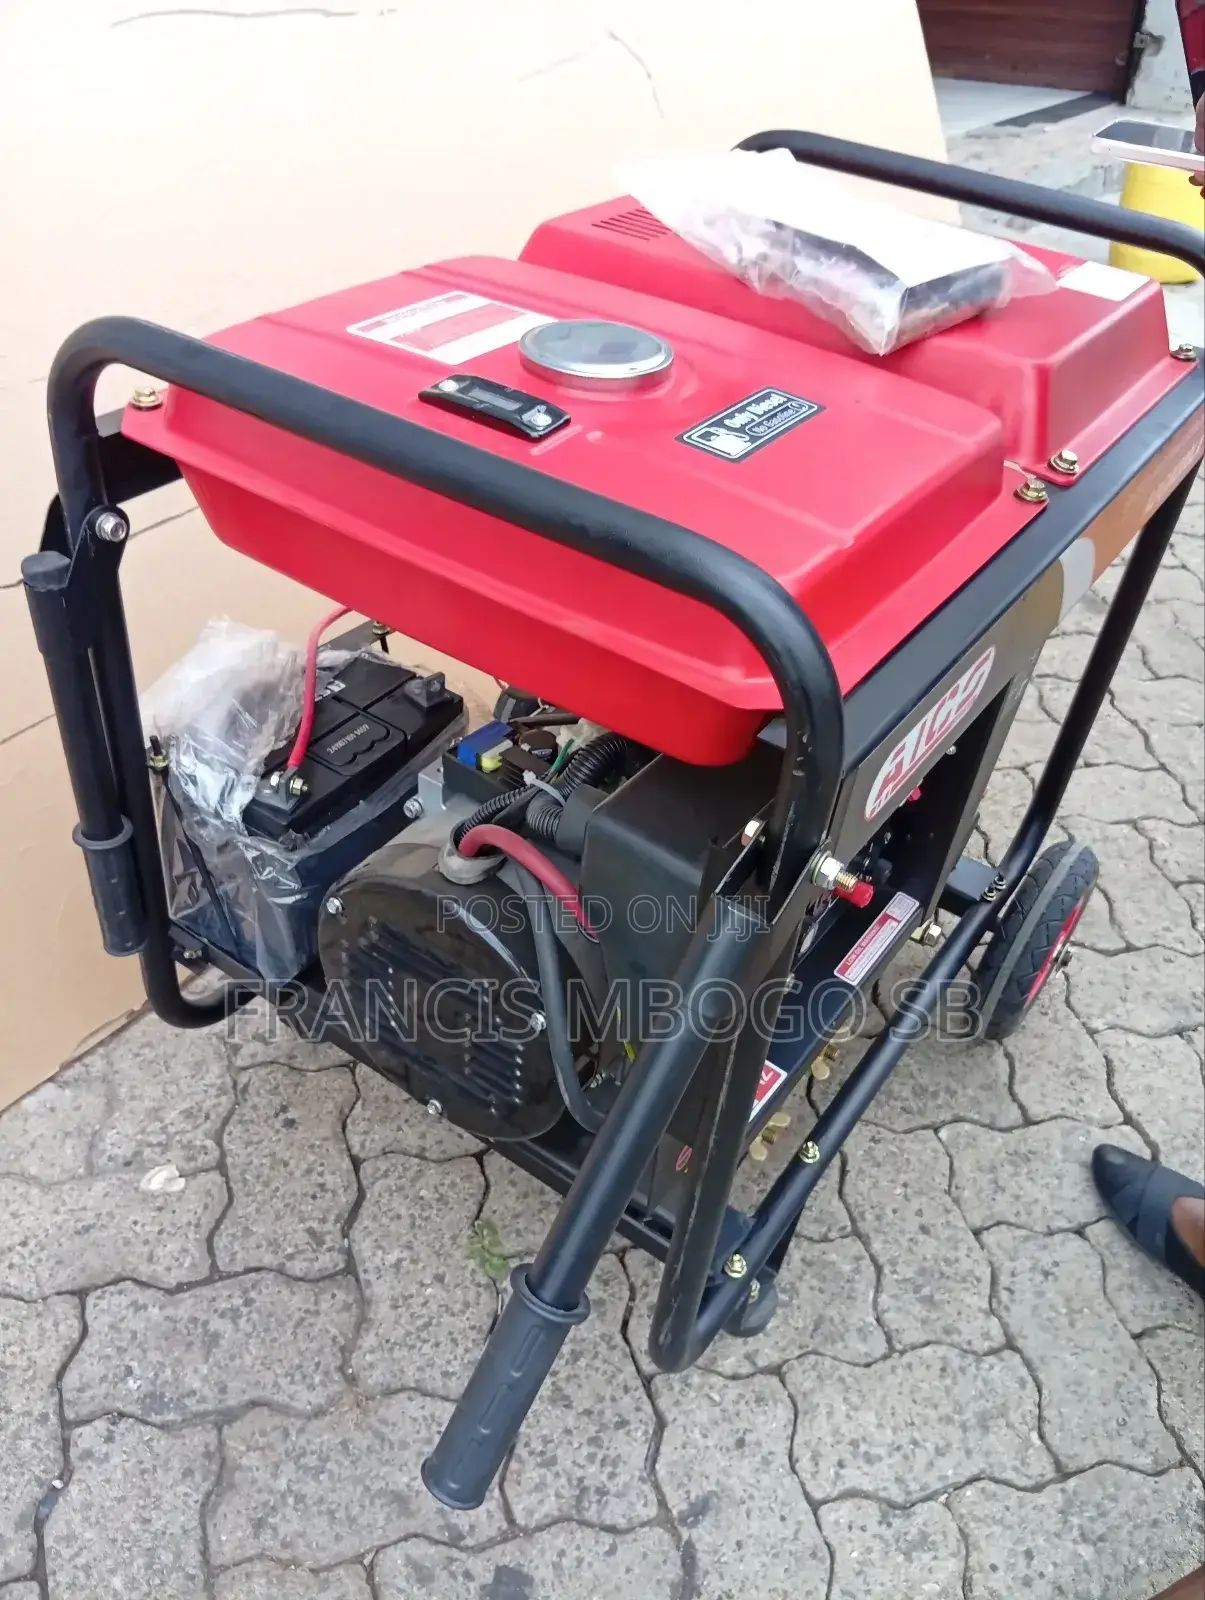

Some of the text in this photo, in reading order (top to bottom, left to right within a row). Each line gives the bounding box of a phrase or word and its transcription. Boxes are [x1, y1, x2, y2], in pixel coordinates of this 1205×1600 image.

[723, 393, 788, 429] Only Diesel
[751, 408, 796, 434] No Gasoline
